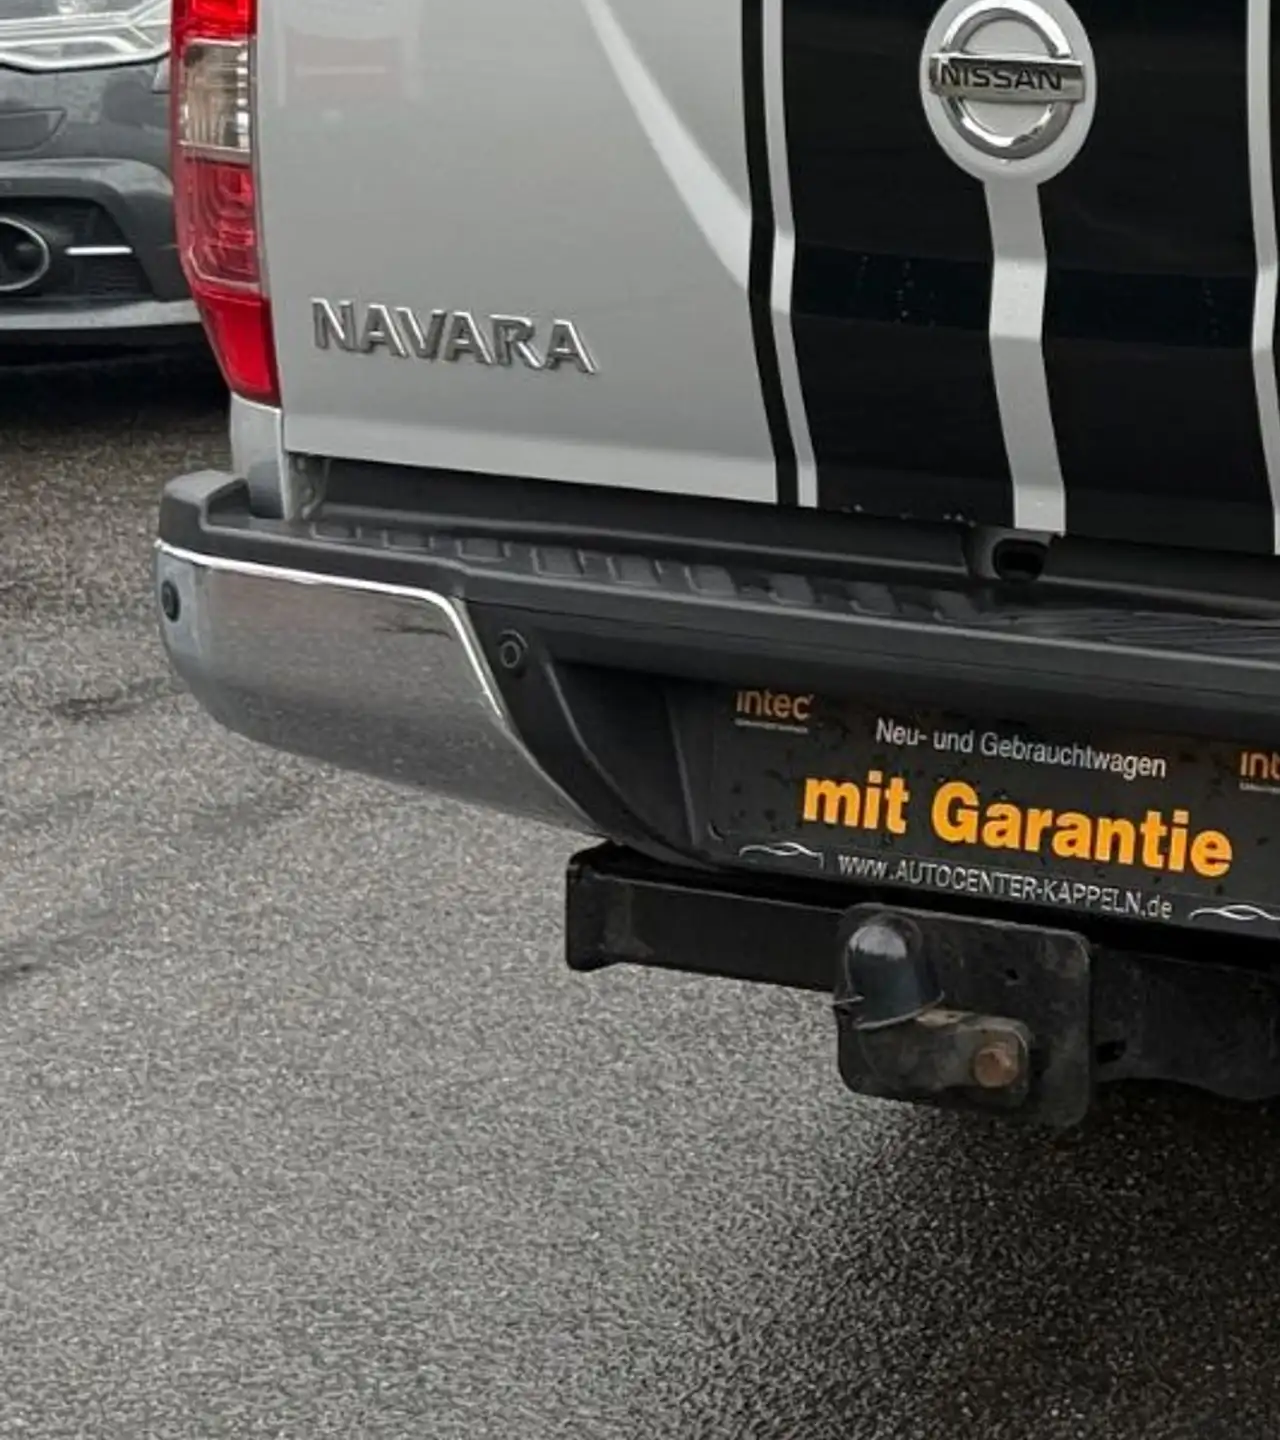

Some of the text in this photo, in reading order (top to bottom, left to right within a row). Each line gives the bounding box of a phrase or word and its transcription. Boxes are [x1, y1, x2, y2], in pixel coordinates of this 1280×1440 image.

[940, 64, 1063, 91] NISSAN
[310, 296, 600, 374] NAVARA
[875, 718, 1167, 781] Neu- und Gebrauchtwagen
[803, 771, 1233, 878] mit Garantie
